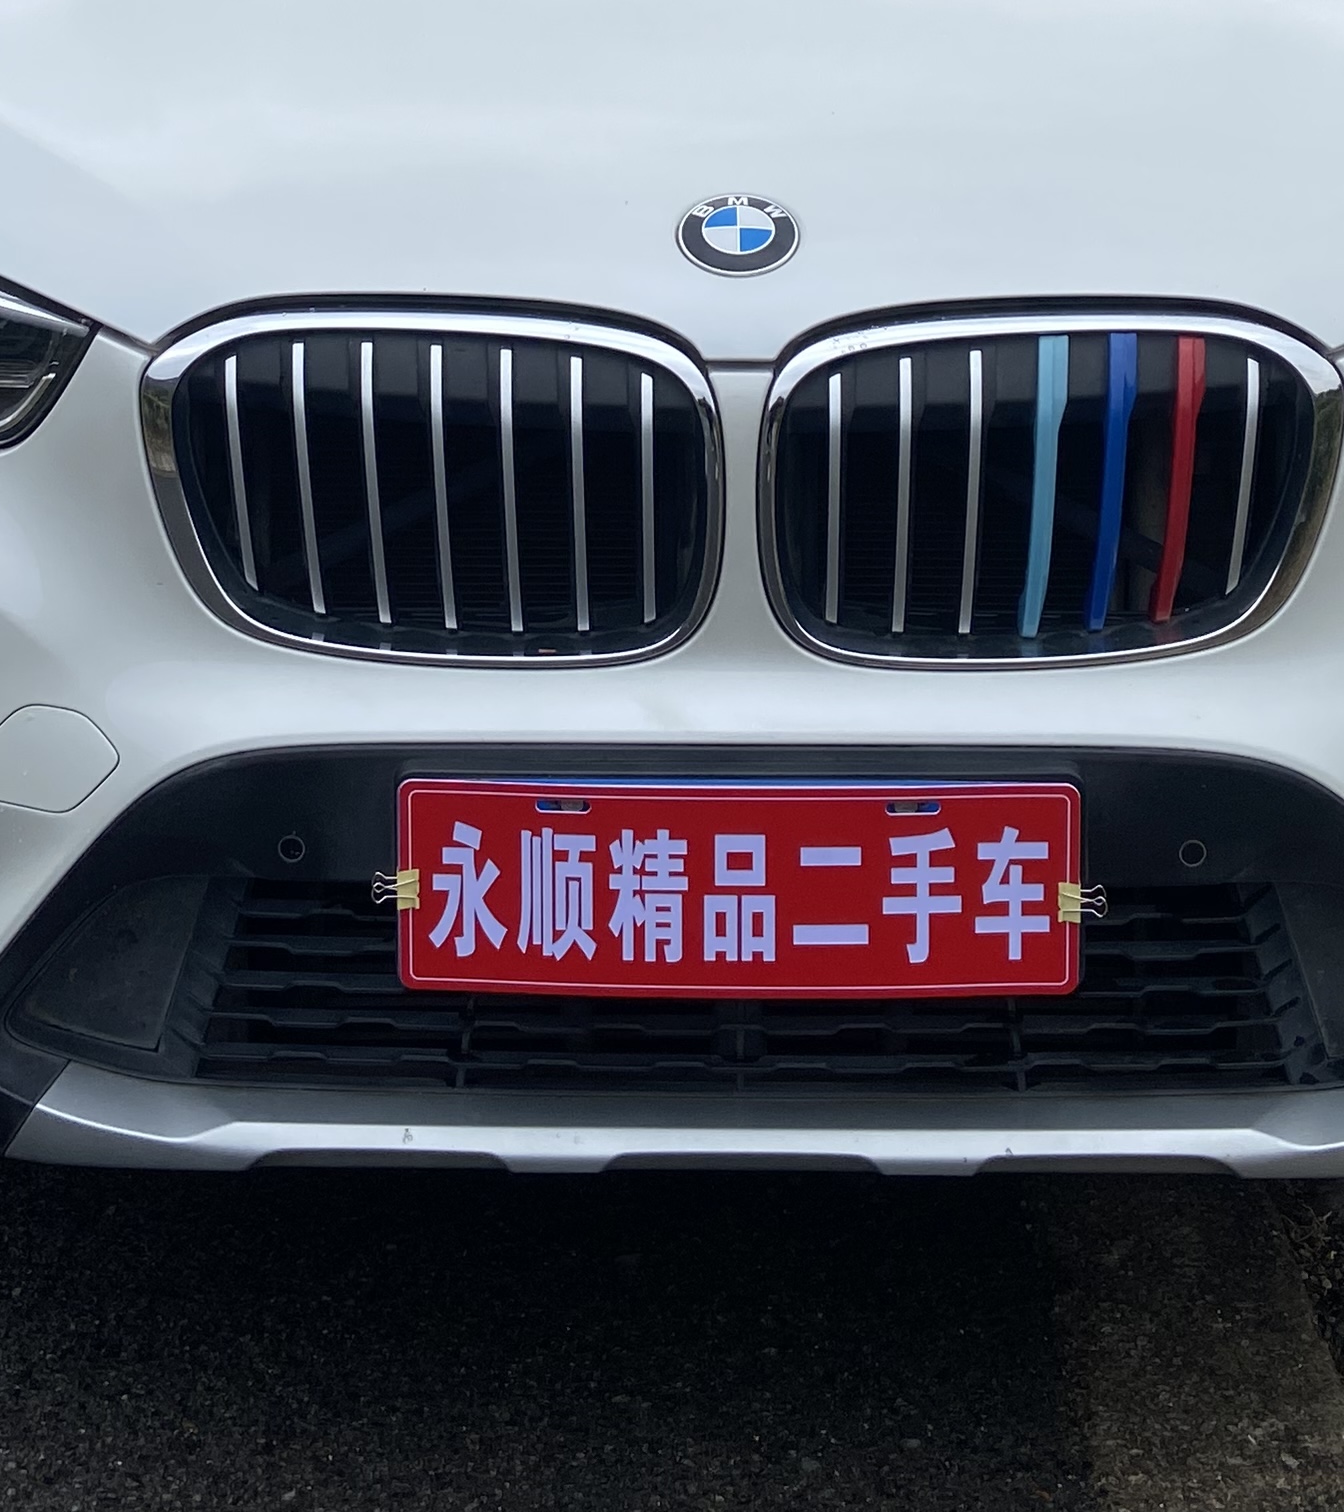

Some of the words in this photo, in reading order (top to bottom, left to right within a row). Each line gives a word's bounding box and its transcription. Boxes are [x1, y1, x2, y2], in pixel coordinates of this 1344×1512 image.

[691, 196, 788, 219] BMW
[428, 821, 1050, 963] 永顺精品二手车
